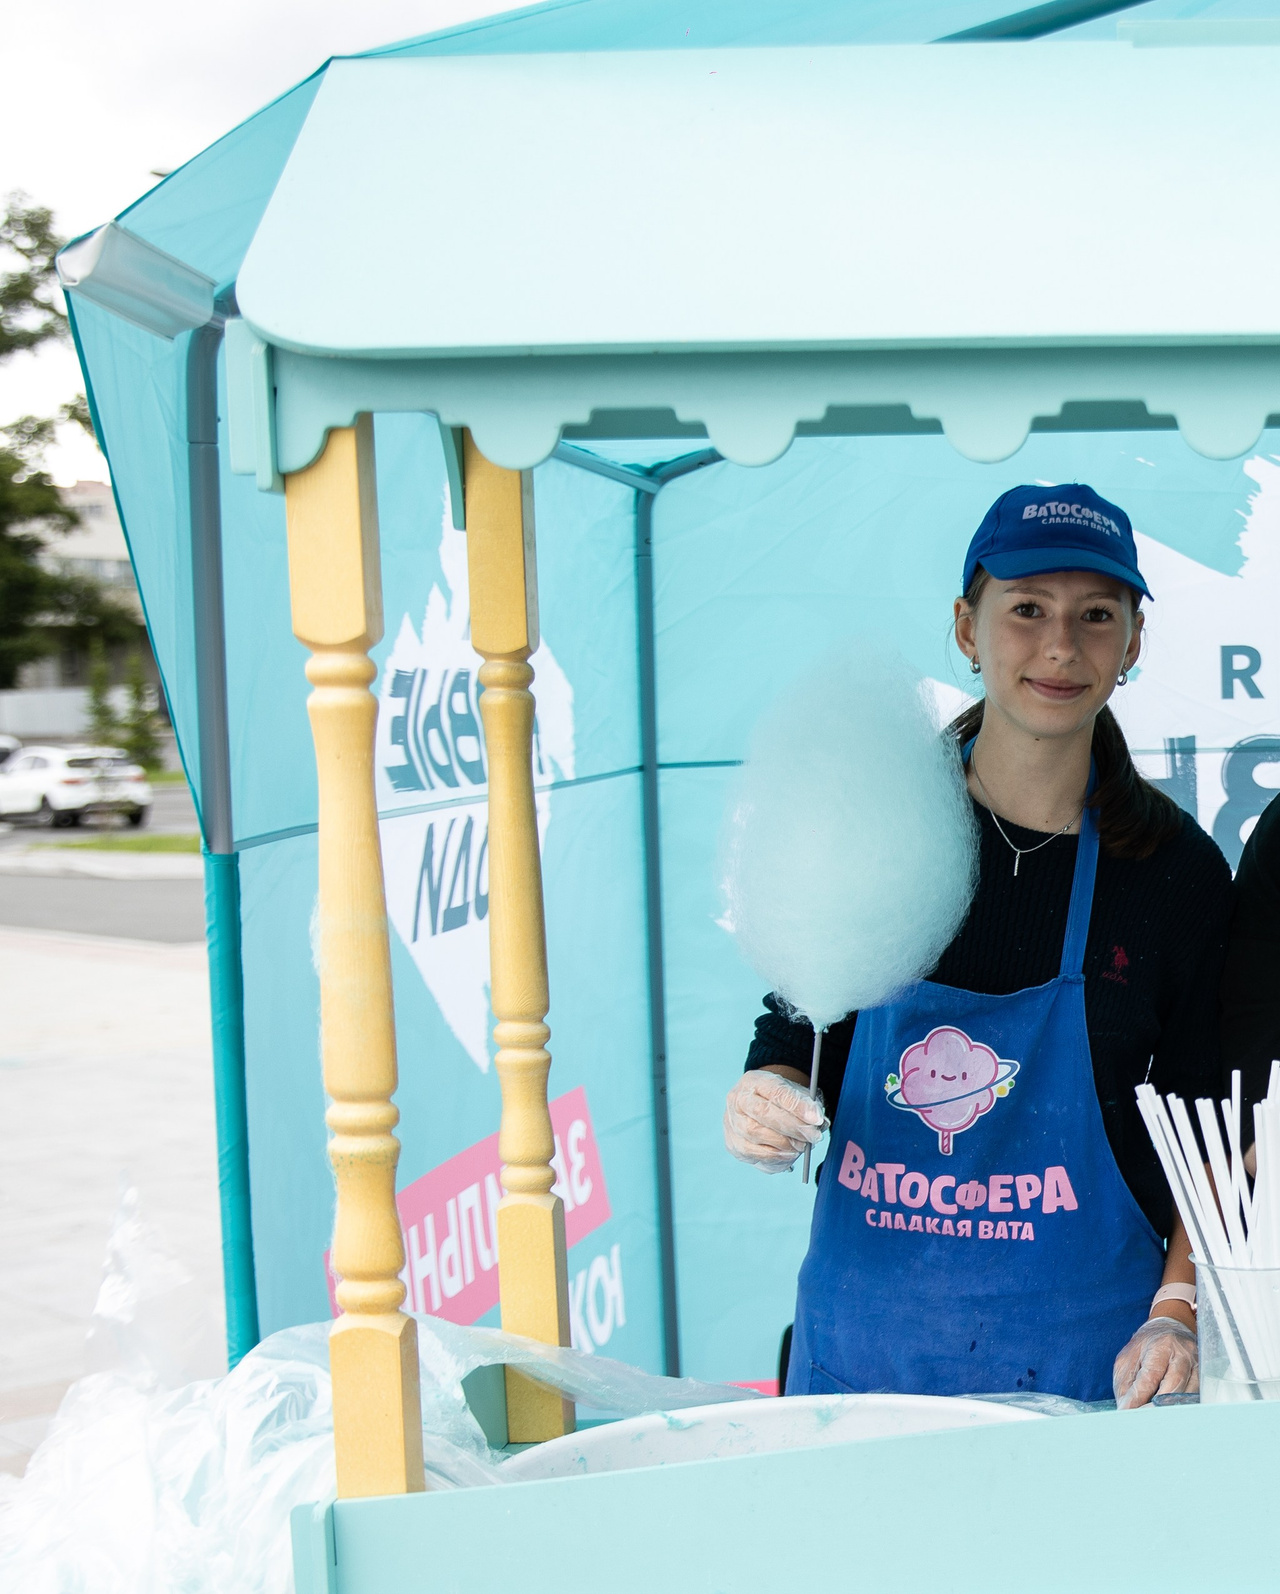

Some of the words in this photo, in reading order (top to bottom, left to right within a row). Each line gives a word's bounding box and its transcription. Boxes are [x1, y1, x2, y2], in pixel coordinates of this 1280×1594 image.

[1022, 501, 1121, 538] ВАТОСФЕРА
[1041, 517, 1089, 527] СЛАДКАЯ
[1090, 522, 1111, 537] ВАТА
[837, 1140, 1078, 1215] ВАТОСФЕРА
[865, 1209, 972, 1238] СЛАДКАЯ
[978, 1220, 1035, 1241] ВАТА
